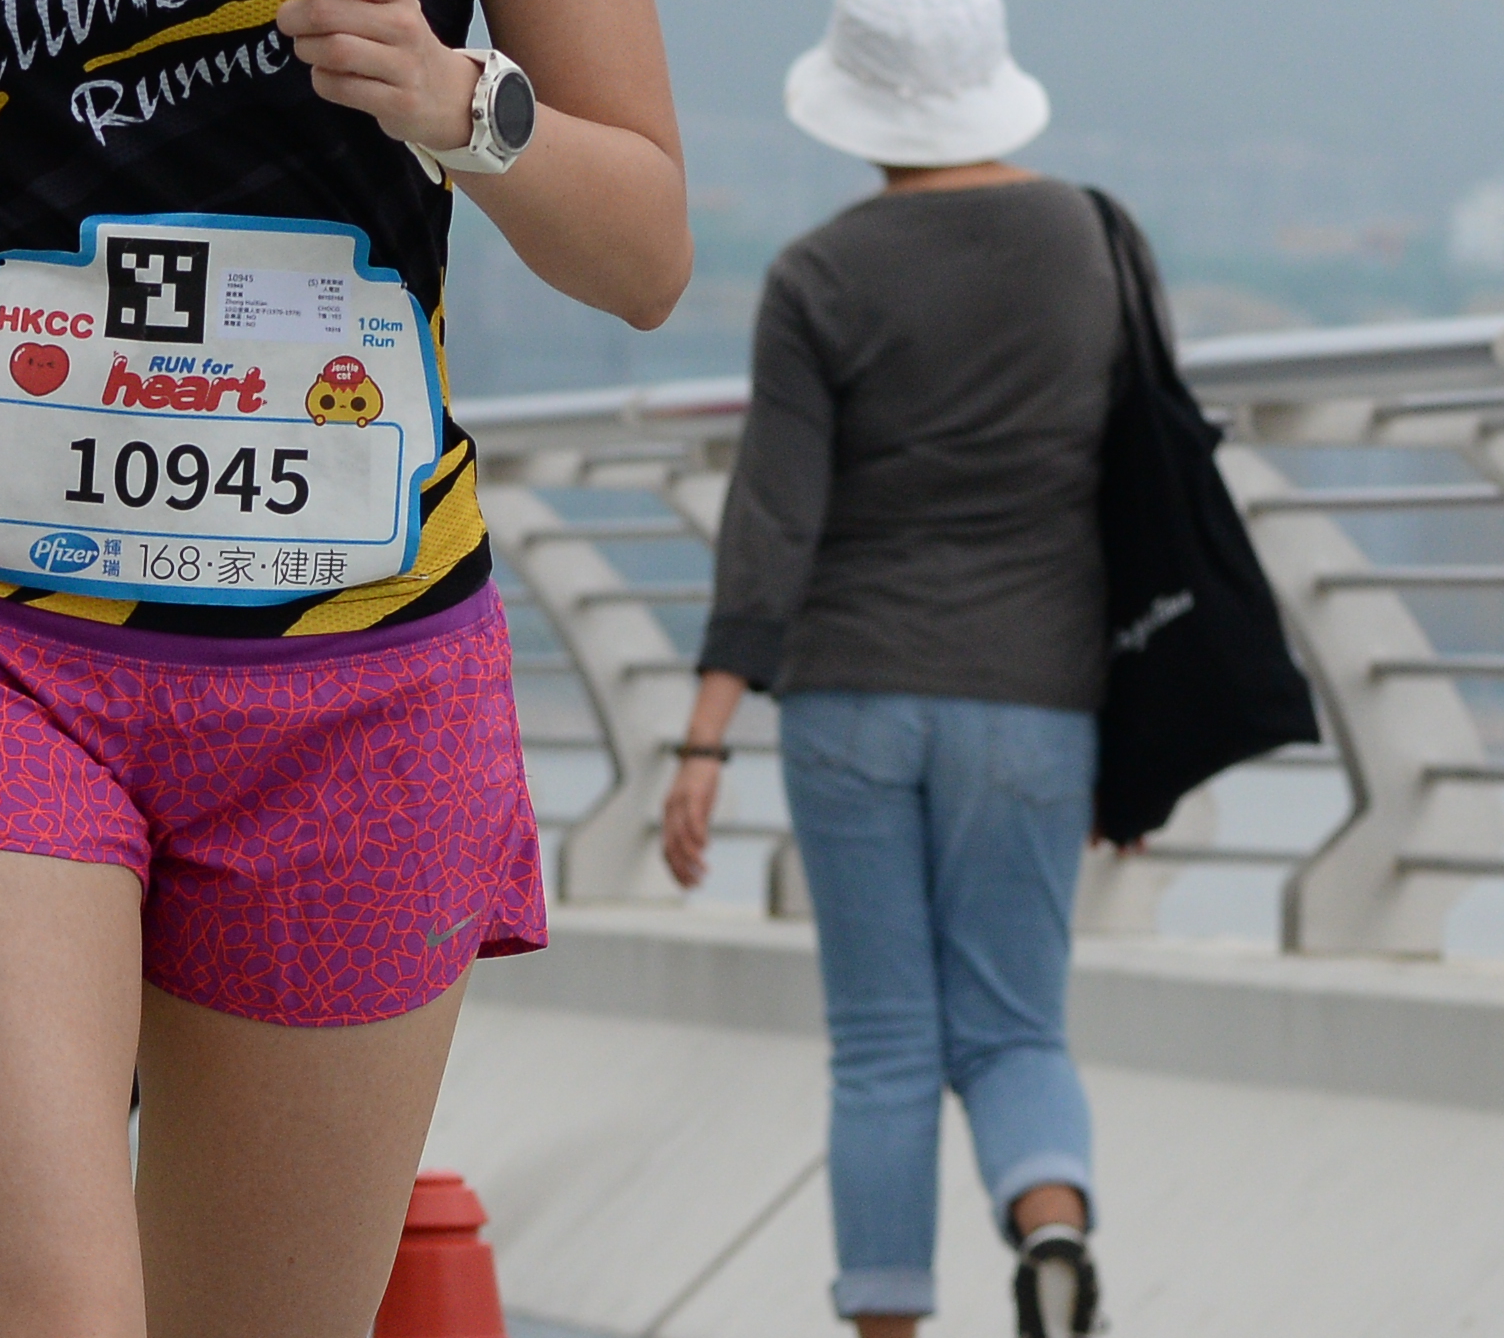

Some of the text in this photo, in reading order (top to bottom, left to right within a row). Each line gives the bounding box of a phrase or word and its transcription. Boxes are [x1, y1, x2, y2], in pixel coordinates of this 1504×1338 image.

[71, 30, 291, 147] Runne
[357, 316, 404, 334] 10km
[363, 333, 395, 349] Run
[102, 353, 267, 413] heart
[149, 355, 234, 375] RUN for
[64, 437, 310, 515] 10945
[34, 535, 98, 572] Pfizer
[102, 537, 122, 578] 輝瑞
